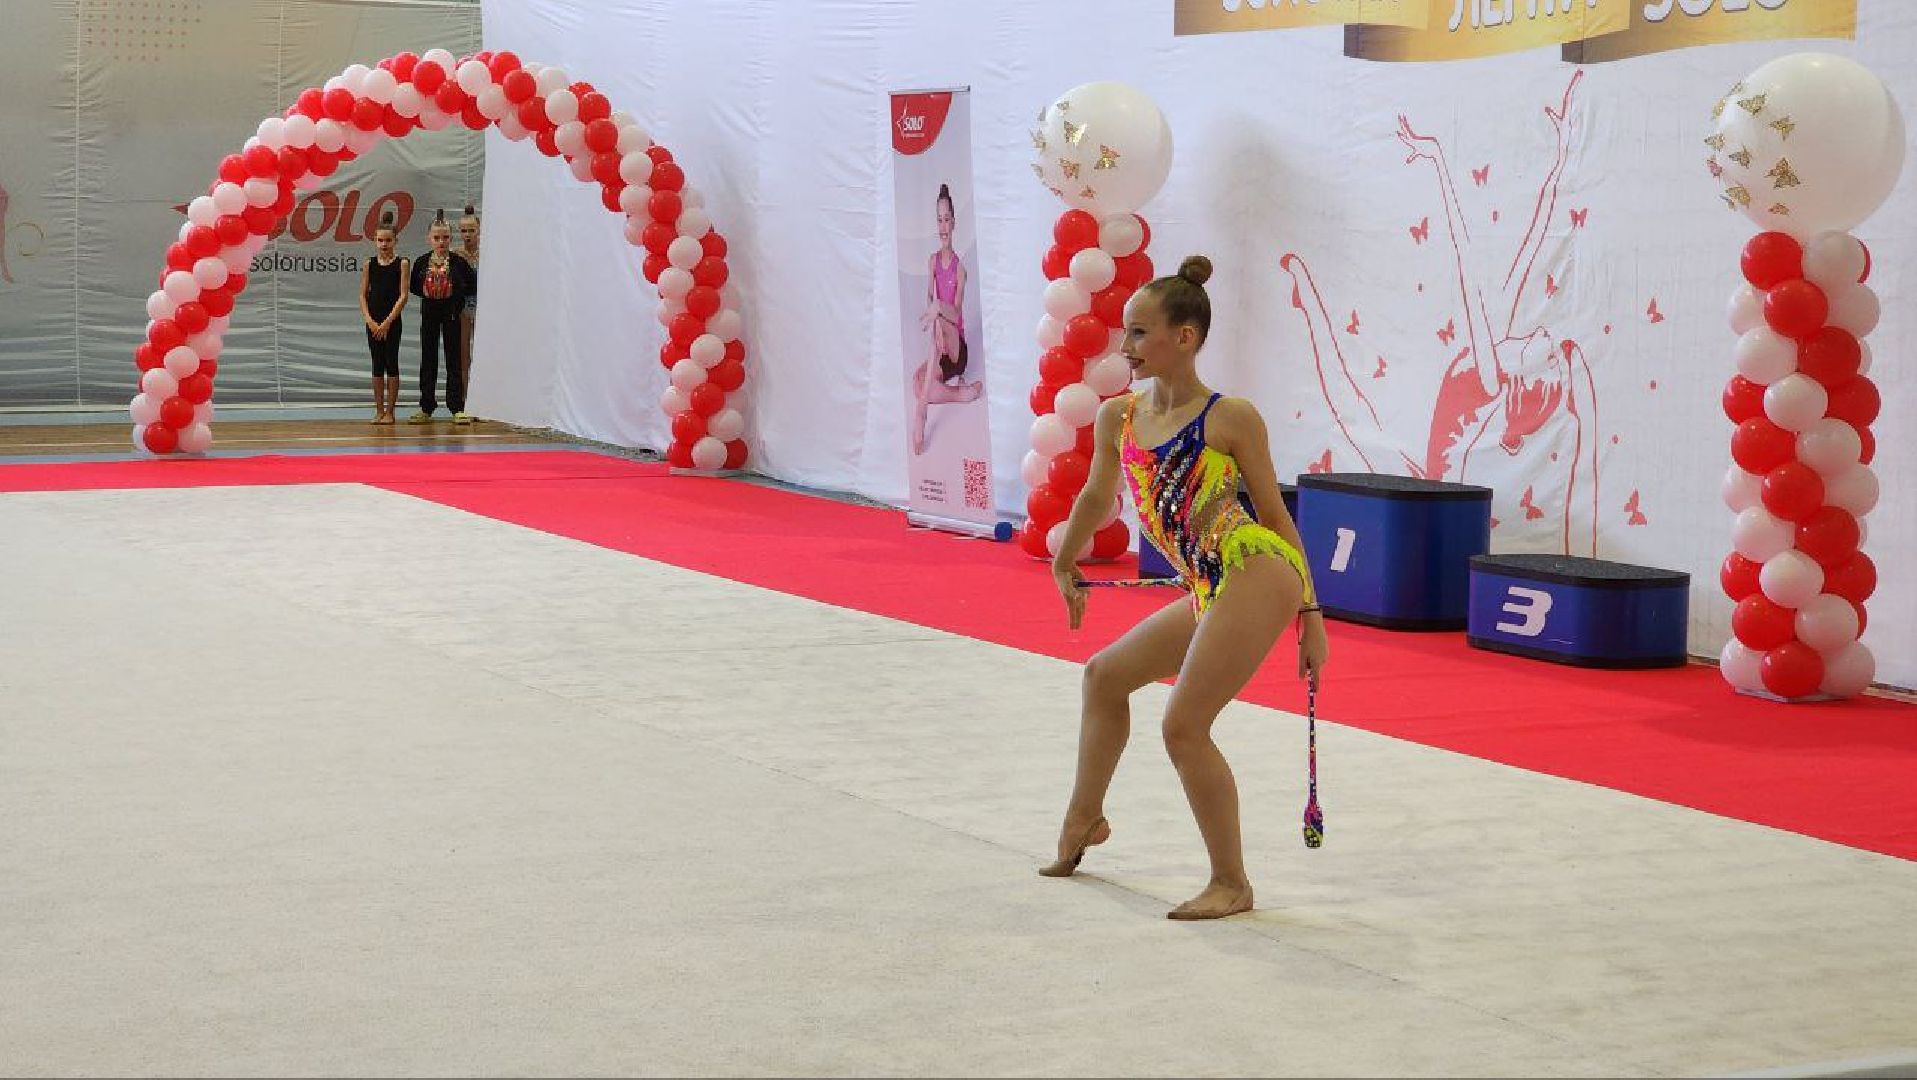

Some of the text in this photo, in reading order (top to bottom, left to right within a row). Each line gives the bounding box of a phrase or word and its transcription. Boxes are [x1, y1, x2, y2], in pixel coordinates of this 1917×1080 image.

[268, 190, 414, 242] OLO
[1330, 528, 1355, 573] 1
[1496, 586, 1552, 637] 3
